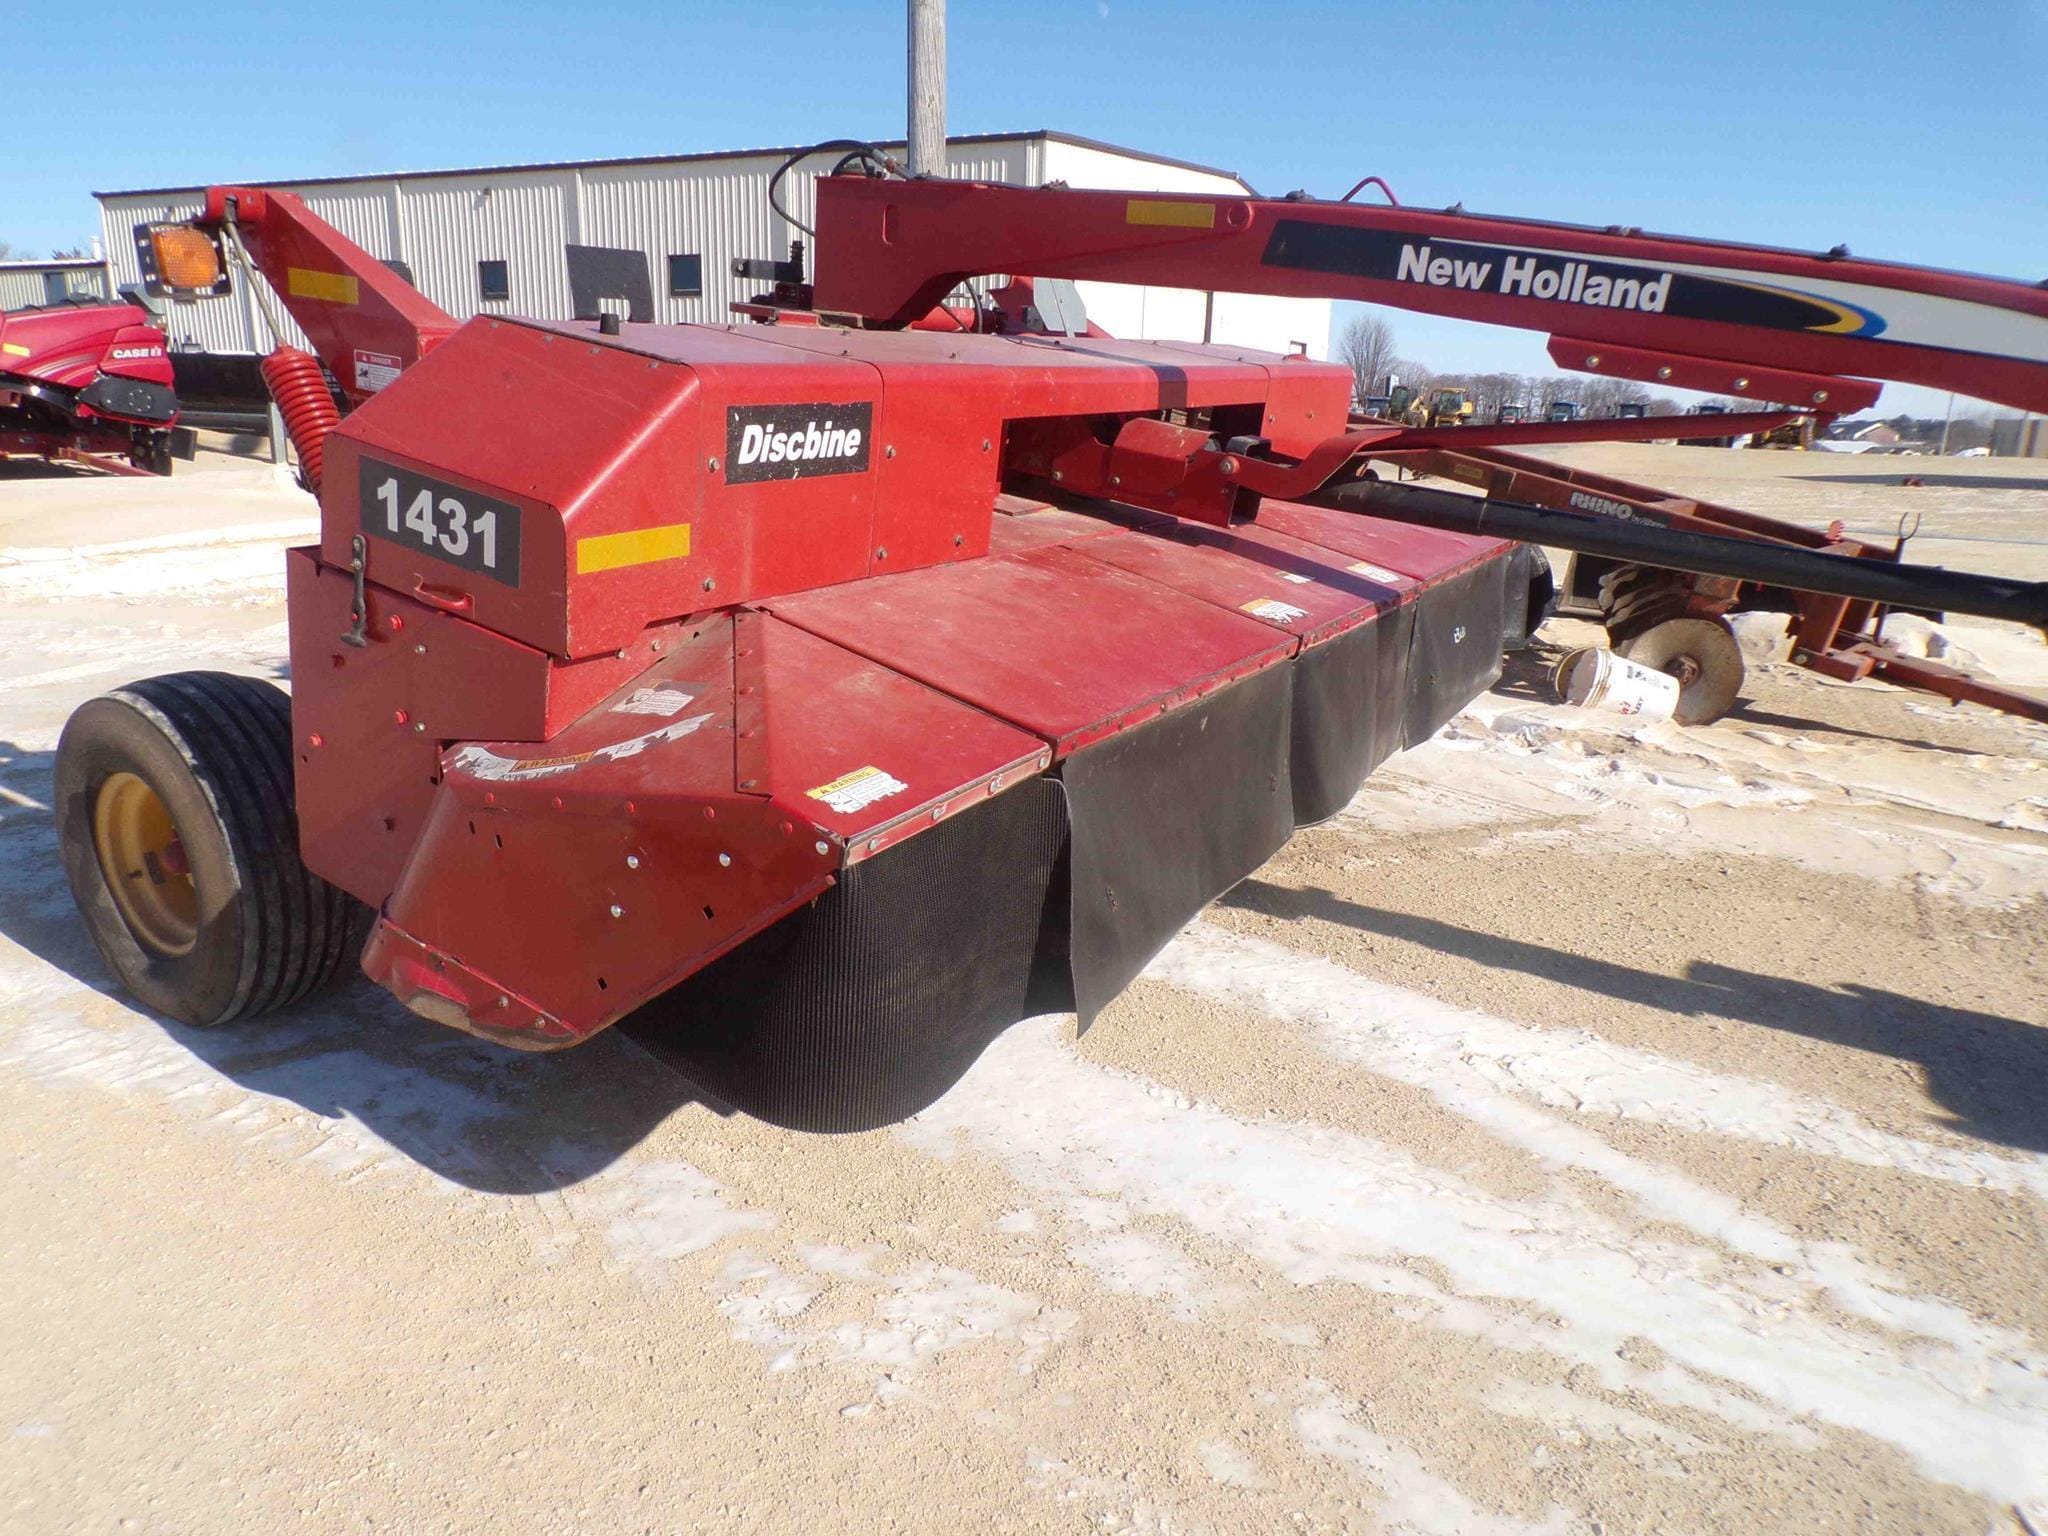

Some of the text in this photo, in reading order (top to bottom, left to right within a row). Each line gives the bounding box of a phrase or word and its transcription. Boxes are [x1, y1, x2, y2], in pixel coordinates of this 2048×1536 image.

[1396, 244, 1673, 313] New Holland
[113, 348, 150, 359] CASE
[738, 421, 862, 465] Discbine
[1570, 491, 1633, 520] RHINO
[377, 477, 496, 569] 1431
[530, 755, 588, 767] WARNING
[830, 771, 872, 790] WARNING
